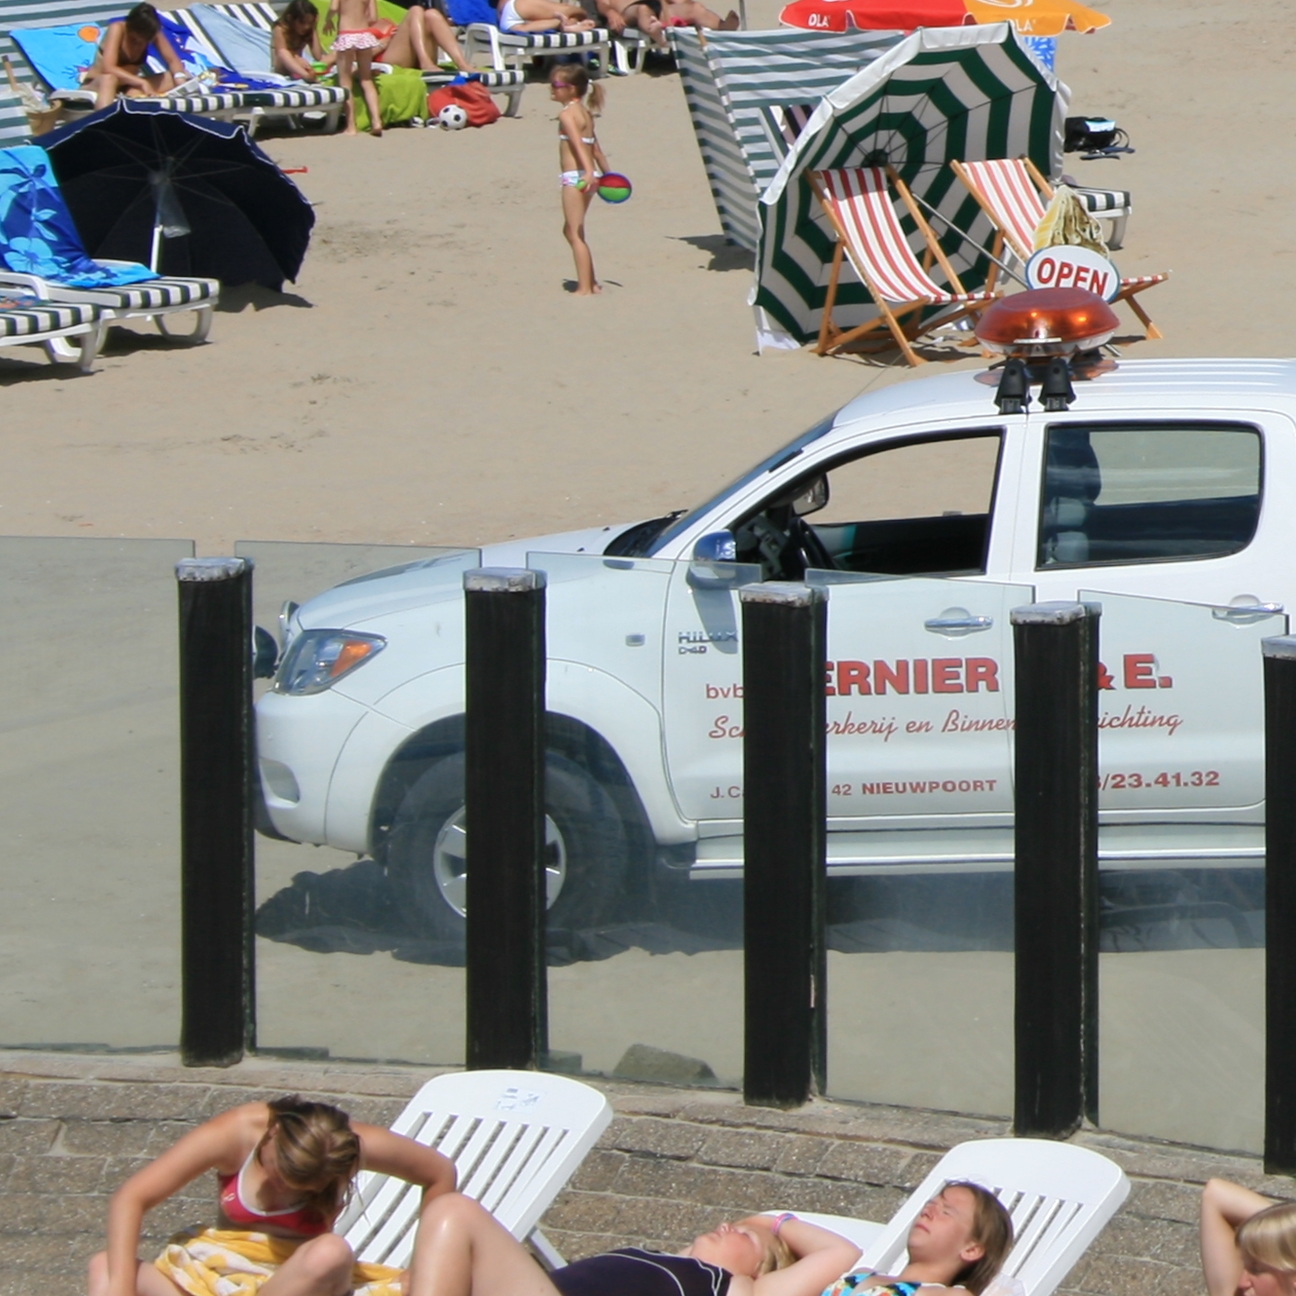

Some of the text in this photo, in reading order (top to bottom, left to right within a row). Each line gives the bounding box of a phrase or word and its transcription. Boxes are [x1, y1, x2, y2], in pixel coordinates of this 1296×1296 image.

[808, 13, 828, 27] OLA
[1037, 257, 1109, 297] OPEN
[679, 631, 738, 644] HILUX
[706, 683, 744, 699] bvb
[1124, 653, 1173, 690] E.
[906, 720, 933, 733] en
[831, 784, 852, 796] 42
[862, 779, 996, 795] NIEUWPOORT
